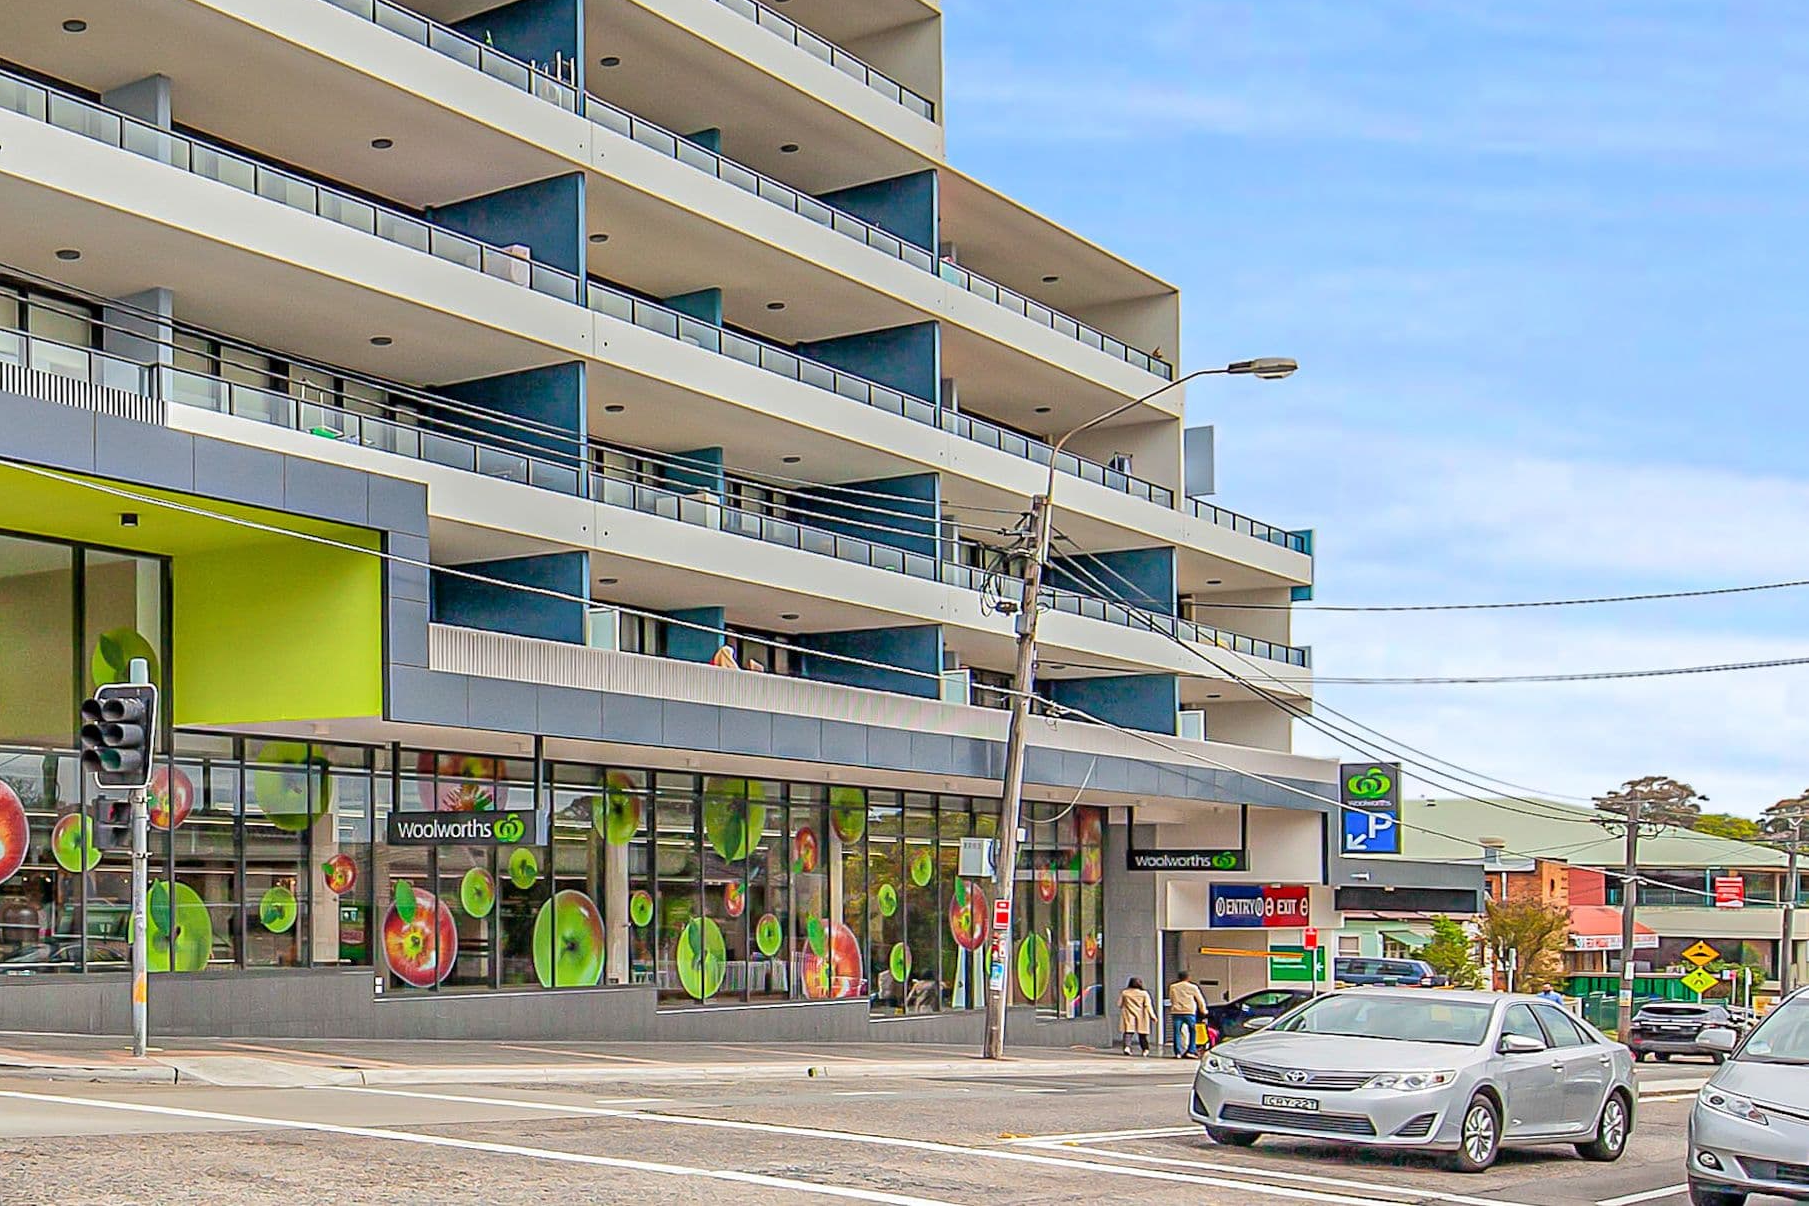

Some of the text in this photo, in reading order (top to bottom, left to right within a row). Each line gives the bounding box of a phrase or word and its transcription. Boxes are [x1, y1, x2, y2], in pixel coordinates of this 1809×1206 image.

[397, 818, 492, 838] Woolworths
[1368, 813, 1392, 839] P
[1226, 898, 1298, 915] ENTRY EXIT
